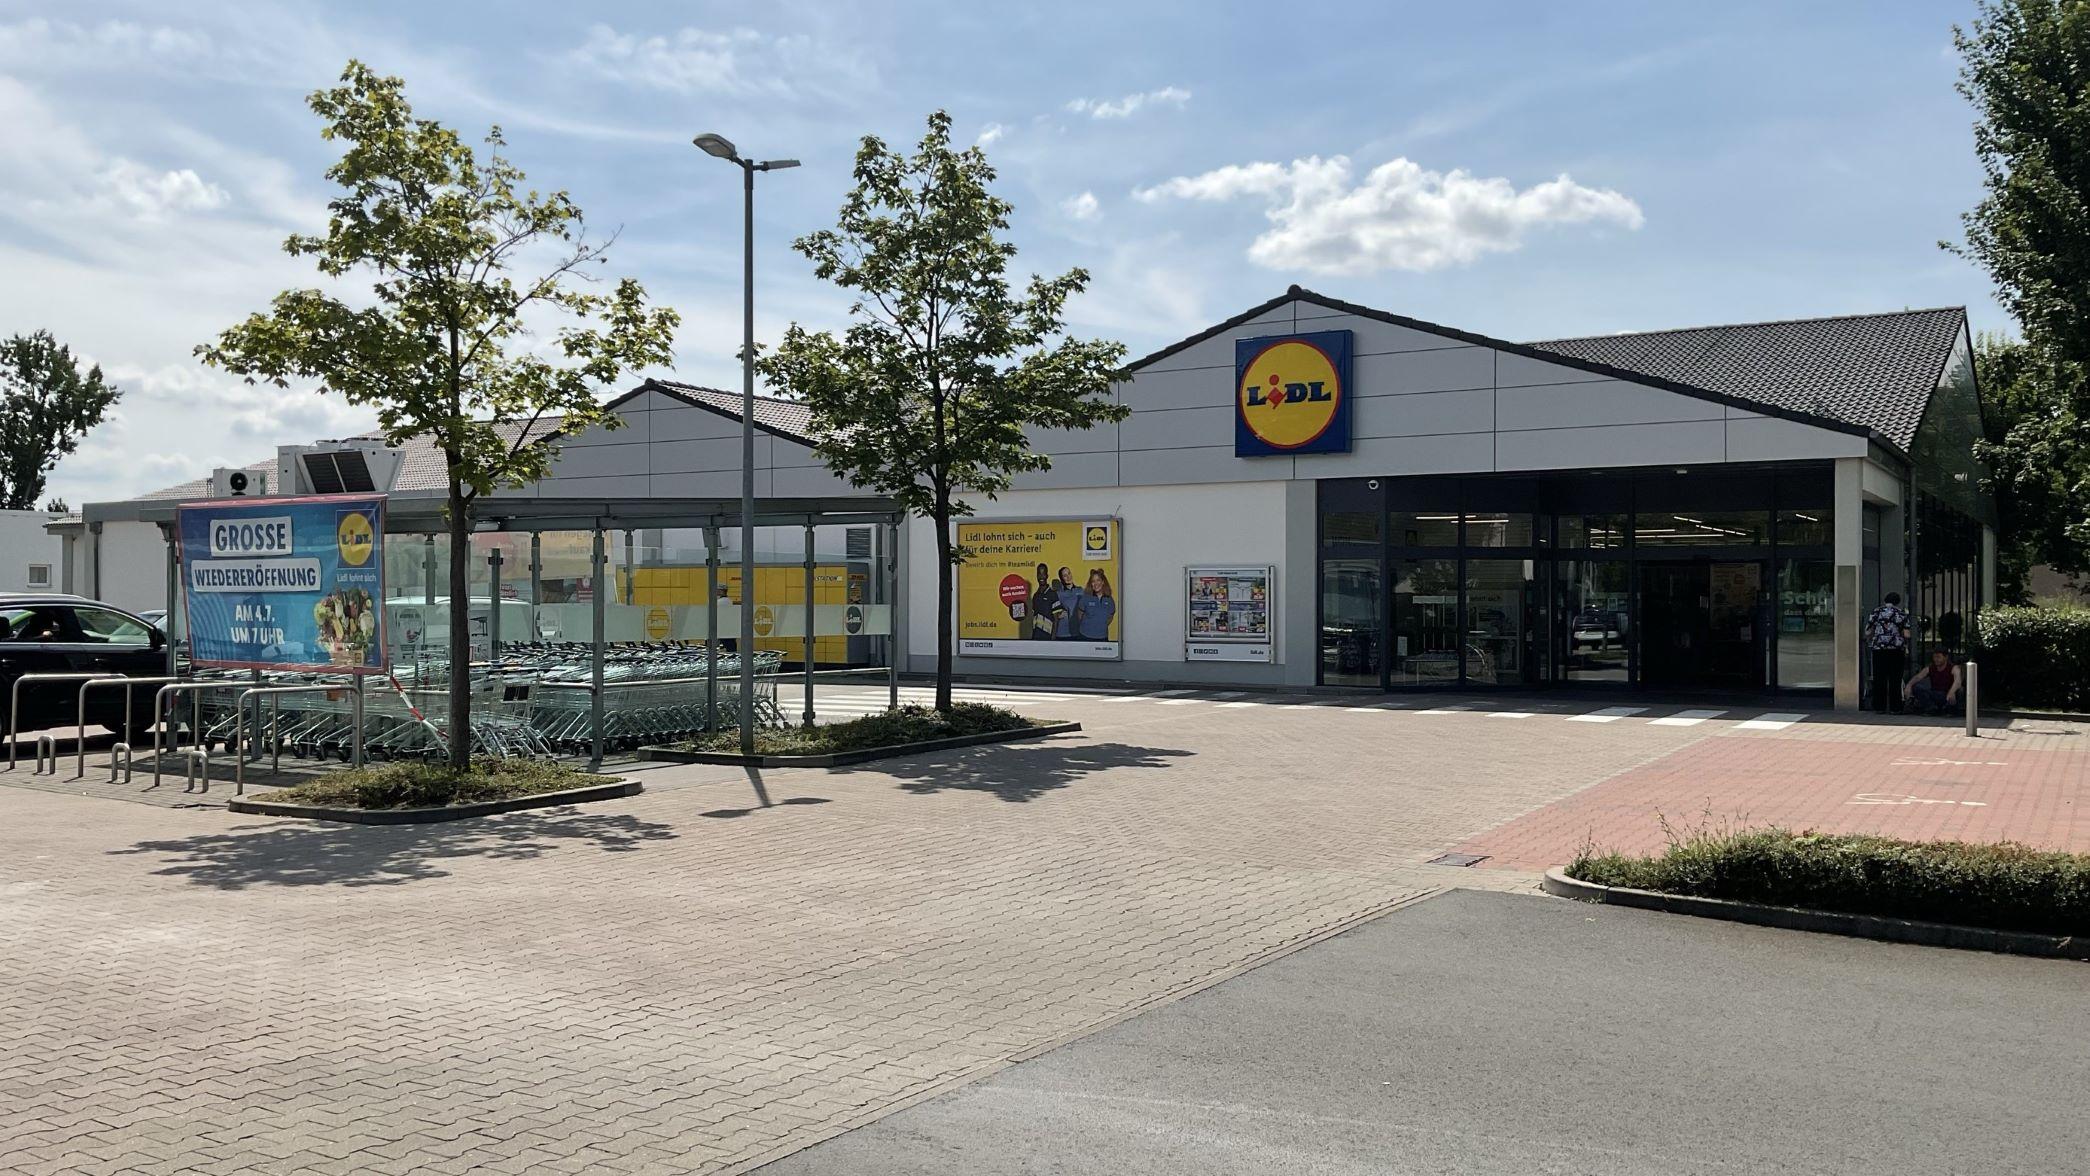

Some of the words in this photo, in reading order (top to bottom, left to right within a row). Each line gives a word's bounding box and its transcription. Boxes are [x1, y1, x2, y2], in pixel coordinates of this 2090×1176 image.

[215, 523, 286, 552] GROSSE
[965, 532, 981, 542] Lidl
[983, 532, 1006, 541] lohnt
[1007, 531, 1025, 541] sich
[1034, 531, 1056, 540] auch
[979, 545, 1003, 554] deine
[1006, 544, 1042, 553] Karriere!
[194, 564, 316, 587] WIEDERERÖFFNUNG
[349, 574, 364, 582] lohnt
[364, 574, 376, 582] sich
[235, 605, 253, 622] AM
[255, 605, 275, 622] 4.7.
[965, 621, 997, 629] jobs.lidl.de
[230, 628, 250, 644] UM
[252, 629, 258, 644] 7
[260, 628, 285, 645] UHR
